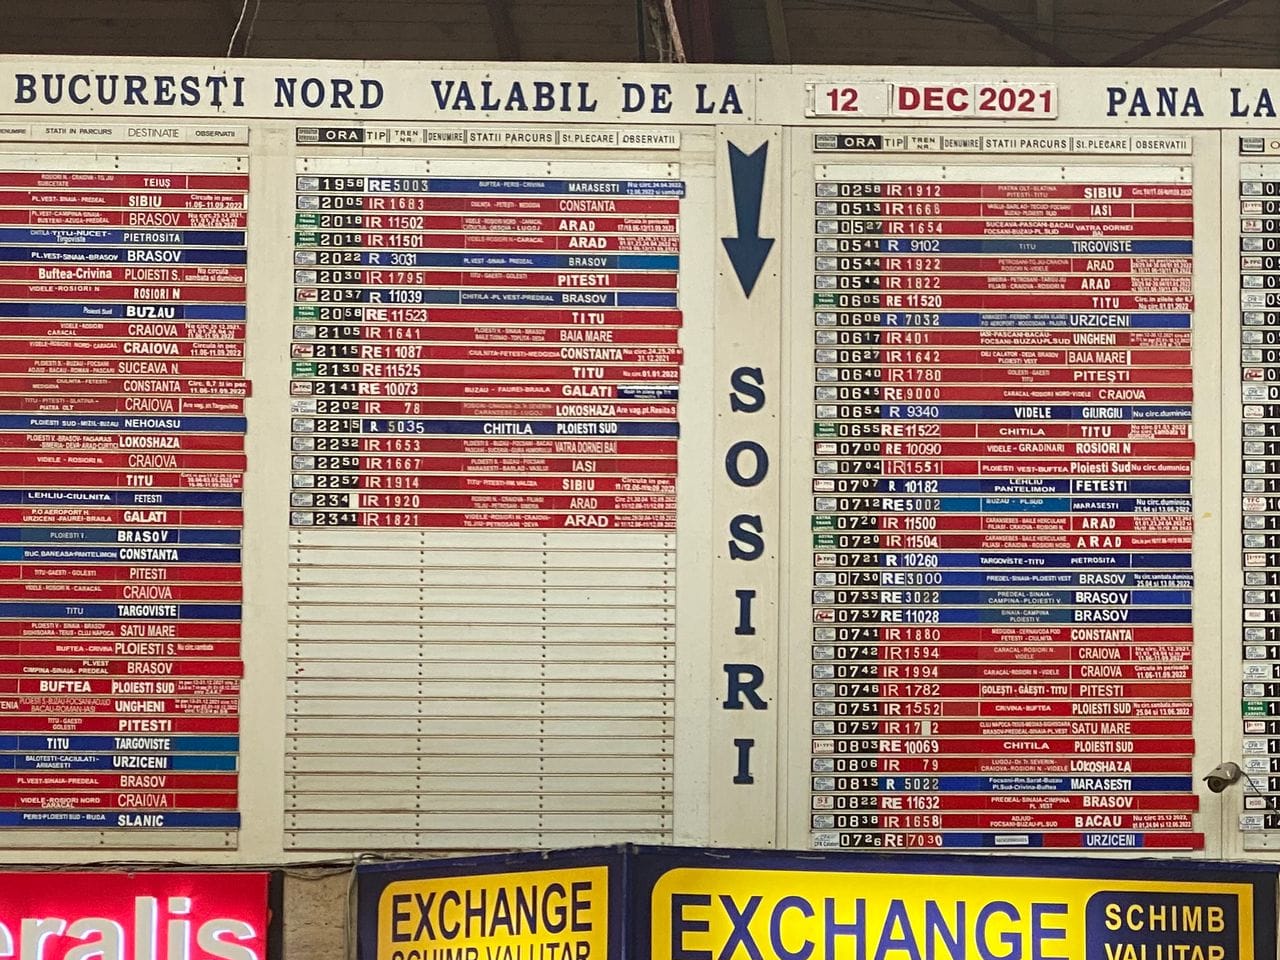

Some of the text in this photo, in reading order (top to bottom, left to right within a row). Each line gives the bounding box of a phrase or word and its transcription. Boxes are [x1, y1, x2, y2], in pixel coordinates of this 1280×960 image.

[274, 78, 383, 109] NORD
[431, 80, 596, 113] VALABIL
[621, 83, 672, 114] DE
[696, 84, 743, 114] LA
[826, 88, 858, 112] 12
[898, 88, 969, 112] DEC
[979, 88, 1052, 113] 2021
[1106, 87, 1204, 117] PANA
[1230, 89, 1277, 117] LA
[844, 137, 877, 148] ORA
[885, 138, 904, 147] TIP
[945, 139, 978, 148] DENUMIRE
[986, 140, 1017, 148] STATII
[1020, 140, 1067, 148] PARCURS
[1088, 140, 1127, 149] PLECARE
[1136, 141, 1187, 149] OBSERVATII
[569, 183, 620, 192] MARASESTI
[559, 220, 595, 231] ARAD
[123, 232, 181, 242] PIETROSITA
[1072, 241, 1132, 252] TIRGOVISTE
[127, 251, 182, 262] BRASOV
[38, 268, 112, 280] Buftea-Crivina
[558, 274, 609, 286] PITESTI
[134, 288, 181, 299] ROSIORI N
[126, 306, 175, 318] BUZAU
[1070, 315, 1129, 327] URZICENI
[1073, 333, 1116, 344] UNGHENI
[562, 385, 612, 397] GALATI
[1014, 407, 1122, 418] VIDELE GIURGIU
[124, 419, 181, 428] NEHOIASU
[483, 423, 617, 434] CHITILA PLOIESTI SUD
[999, 425, 1111, 437] CHITILA TITU
[572, 461, 596, 472] IASI
[126, 474, 153, 486] TITU
[1076, 480, 1128, 492] FETESTI
[124, 511, 167, 523] GALATI
[119, 548, 178, 561] CONSTANTA
[723, 367, 768, 784] SOSIRI
[120, 625, 175, 637] SATU MARE
[1071, 629, 1132, 641] CONSTANTA
[40, 681, 92, 692] BUFTEA
[119, 720, 172, 731] PITESTI
[112, 756, 168, 768] URZICENI
[1070, 760, 1132, 772] LOKOSHAZA
[118, 815, 164, 827] SLANIC
[1075, 816, 1122, 827] BACAU
[1086, 834, 1136, 846] URZICENI
[392, 881, 592, 943] EXCHANGE
[1106, 903, 1226, 932] SCHIMB
